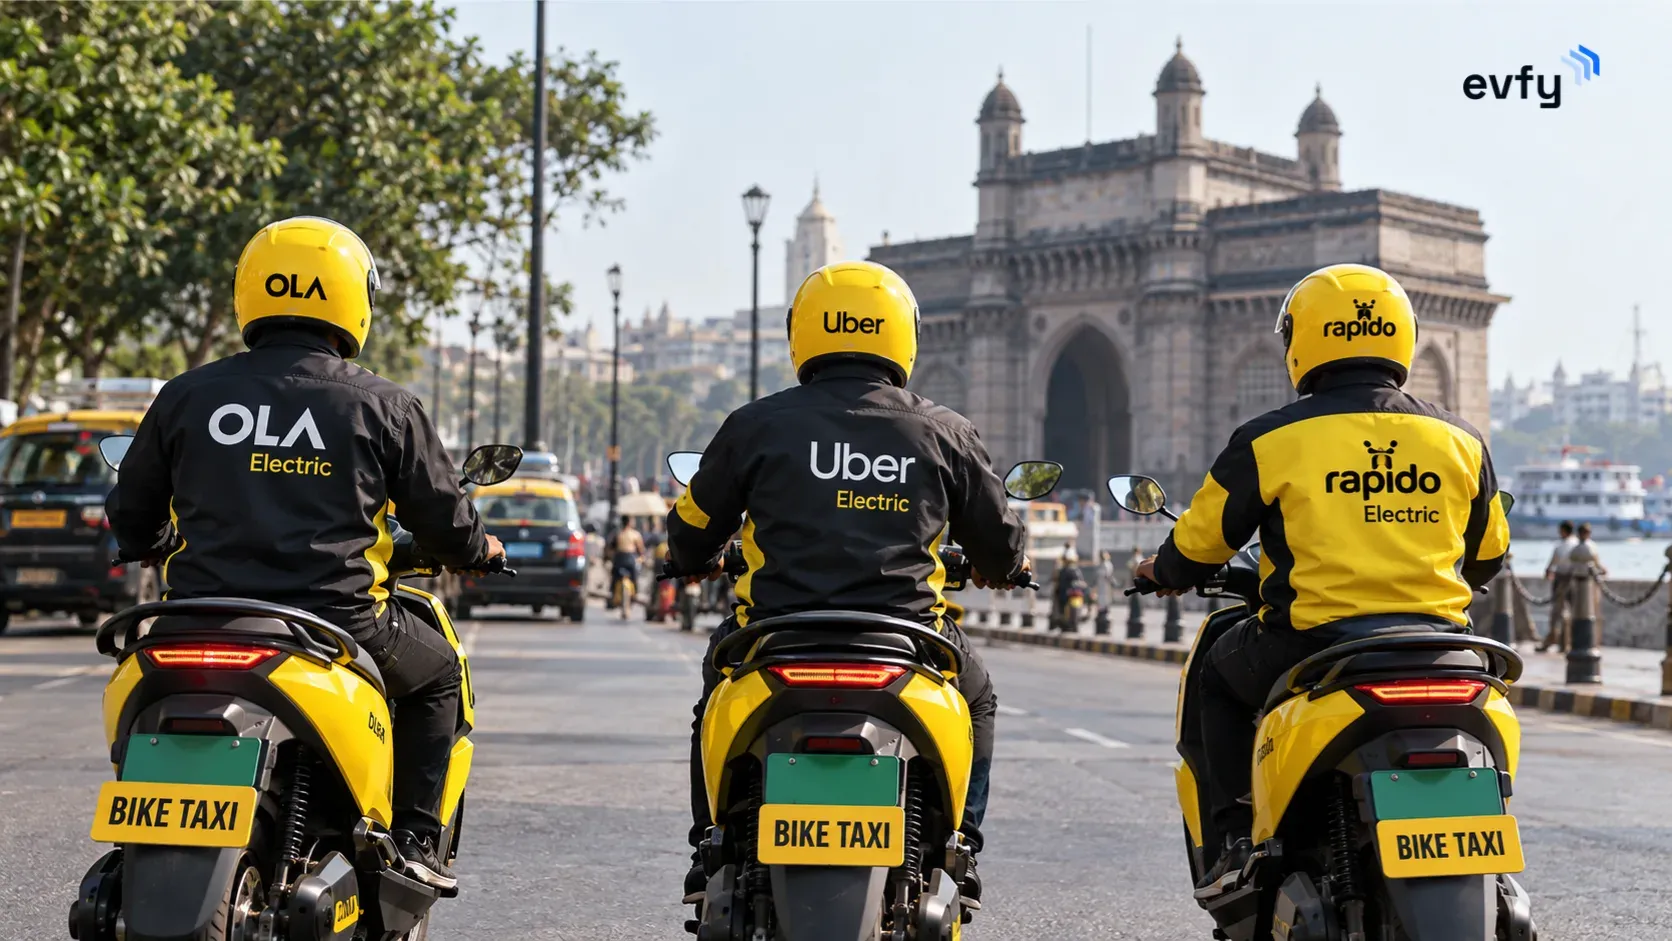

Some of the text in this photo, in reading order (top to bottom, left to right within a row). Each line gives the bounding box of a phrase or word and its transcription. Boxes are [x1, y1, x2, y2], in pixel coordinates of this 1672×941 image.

[264, 272, 328, 301] OLA
[823, 311, 885, 335] Uber
[1323, 315, 1397, 342] rapido
[208, 403, 326, 450] OLA
[249, 452, 332, 477] Electric
[810, 440, 916, 484] Uber
[1325, 463, 1442, 501] rapido
[836, 490, 910, 513] Electric
[1364, 504, 1440, 524] Electric
[108, 796, 239, 831] BIKE TAXI
[774, 819, 890, 849] BIKE TAXI
[1396, 830, 1505, 860] BIKE TAXI
